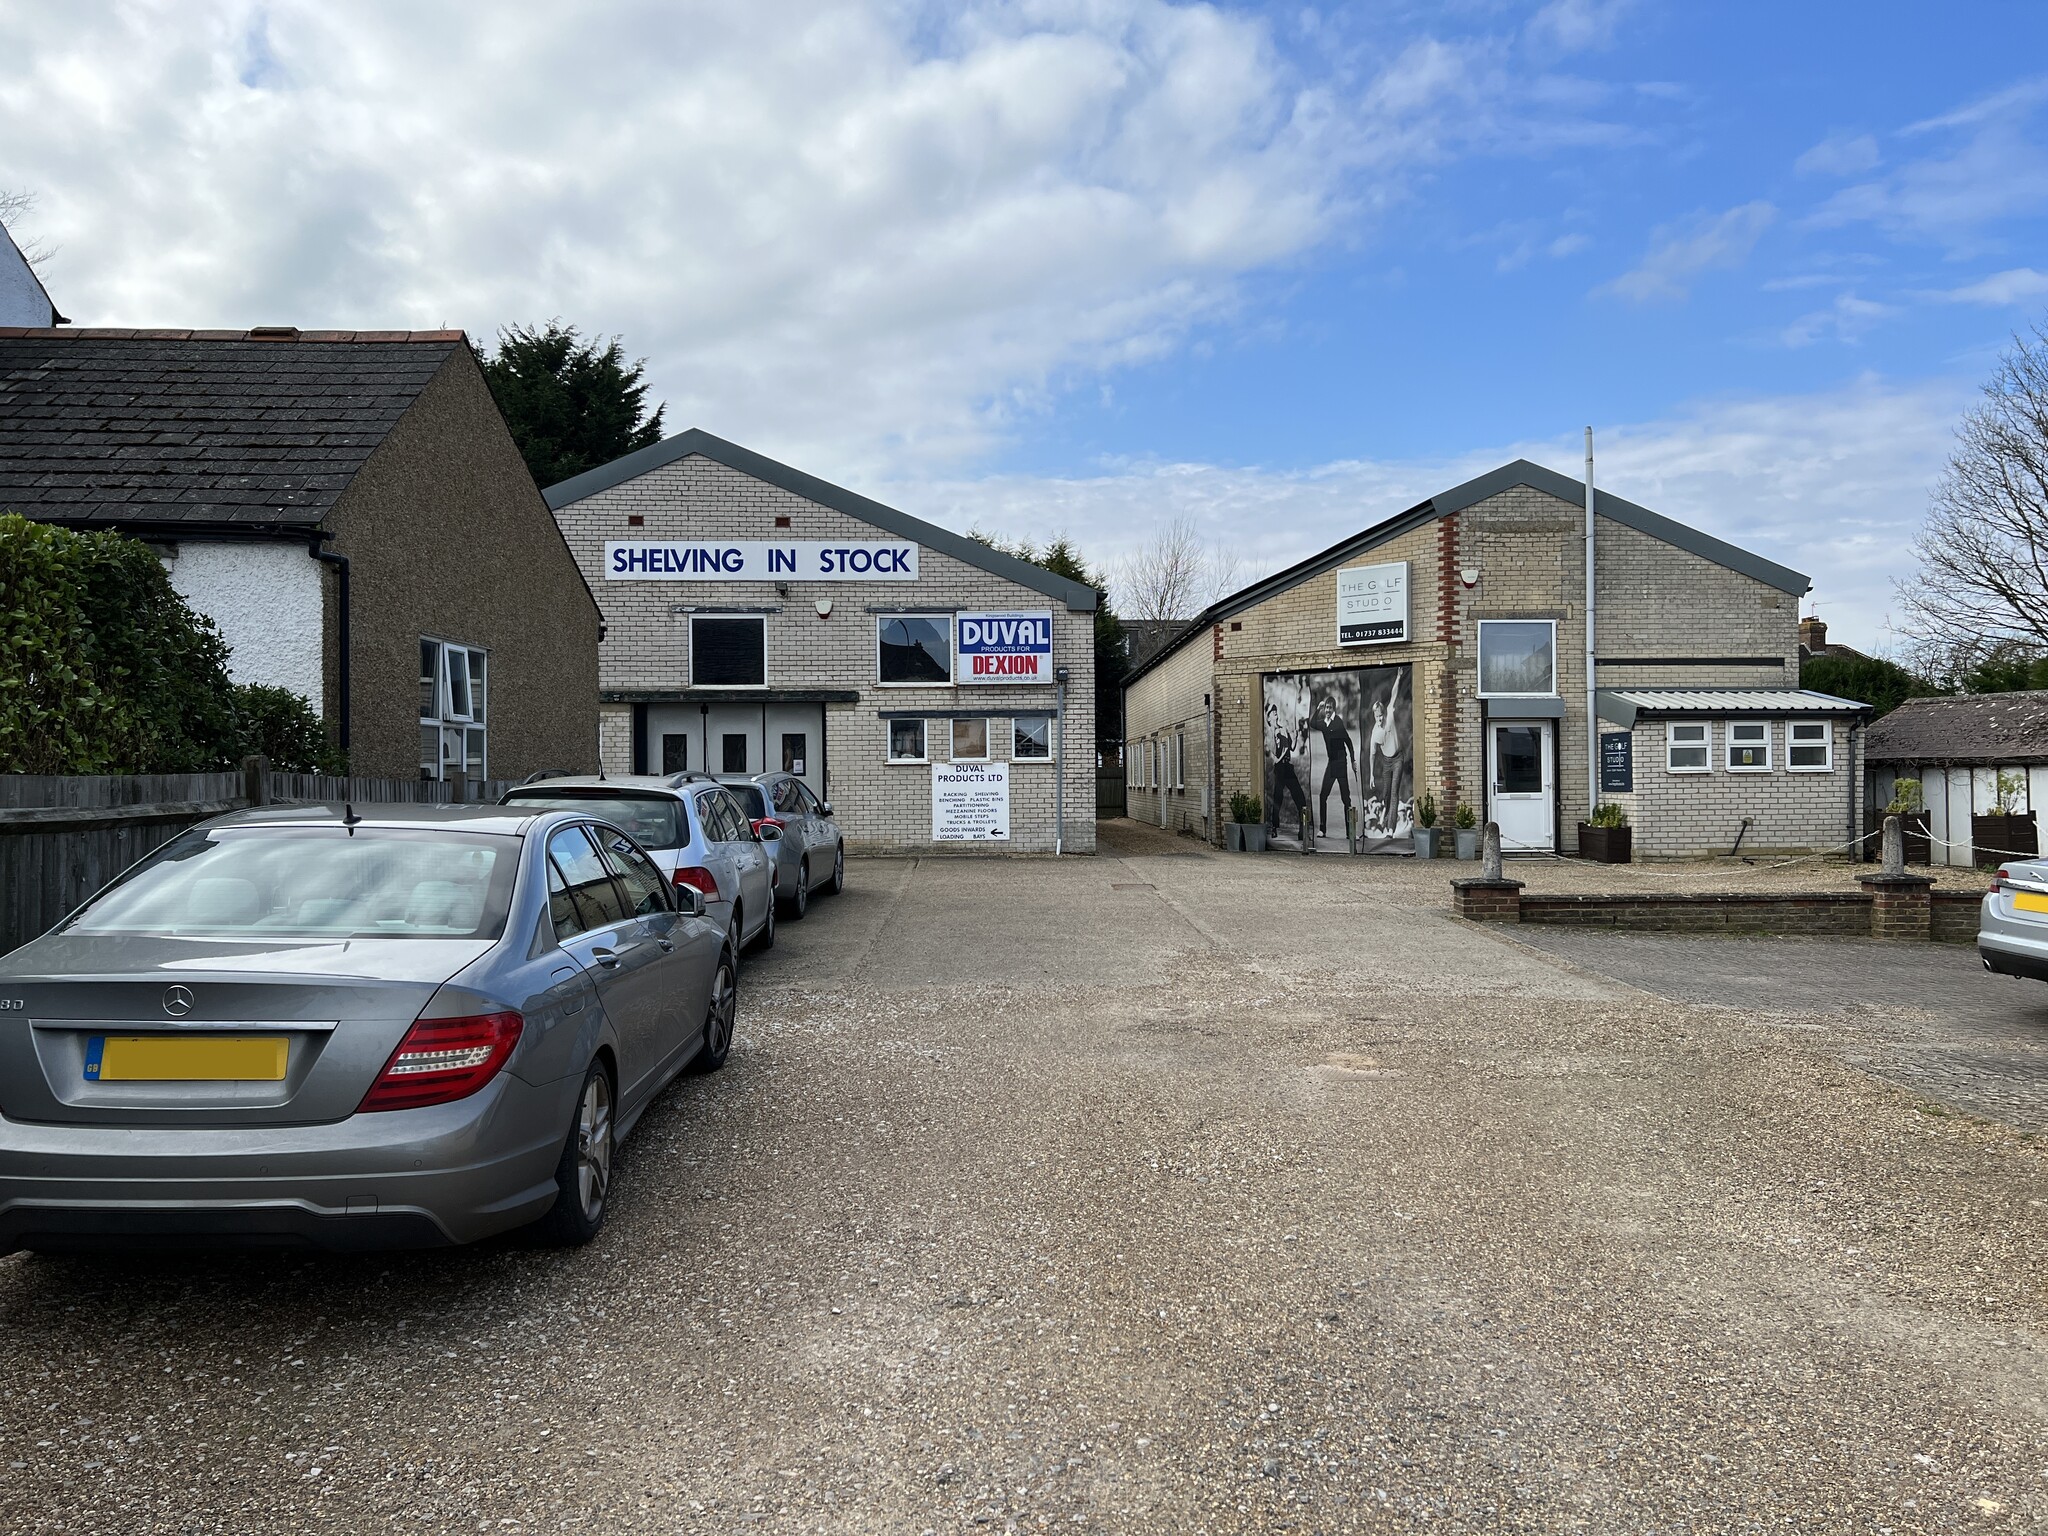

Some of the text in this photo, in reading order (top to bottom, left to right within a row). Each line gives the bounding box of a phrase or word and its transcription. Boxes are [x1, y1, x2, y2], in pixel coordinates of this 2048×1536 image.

[612, 548, 912, 573] SHELVING IN STOCK
[1341, 582, 1364, 592] THE
[962, 620, 1049, 645] DUVAL
[1355, 630, 1377, 638] 01737
[1378, 627, 1403, 636] 833444
[972, 655, 1038, 675] DEXION
[955, 764, 985, 773] DUVAL
[937, 774, 1003, 783] PRODUCTS LTD
[86, 1064, 99, 1073] GB
